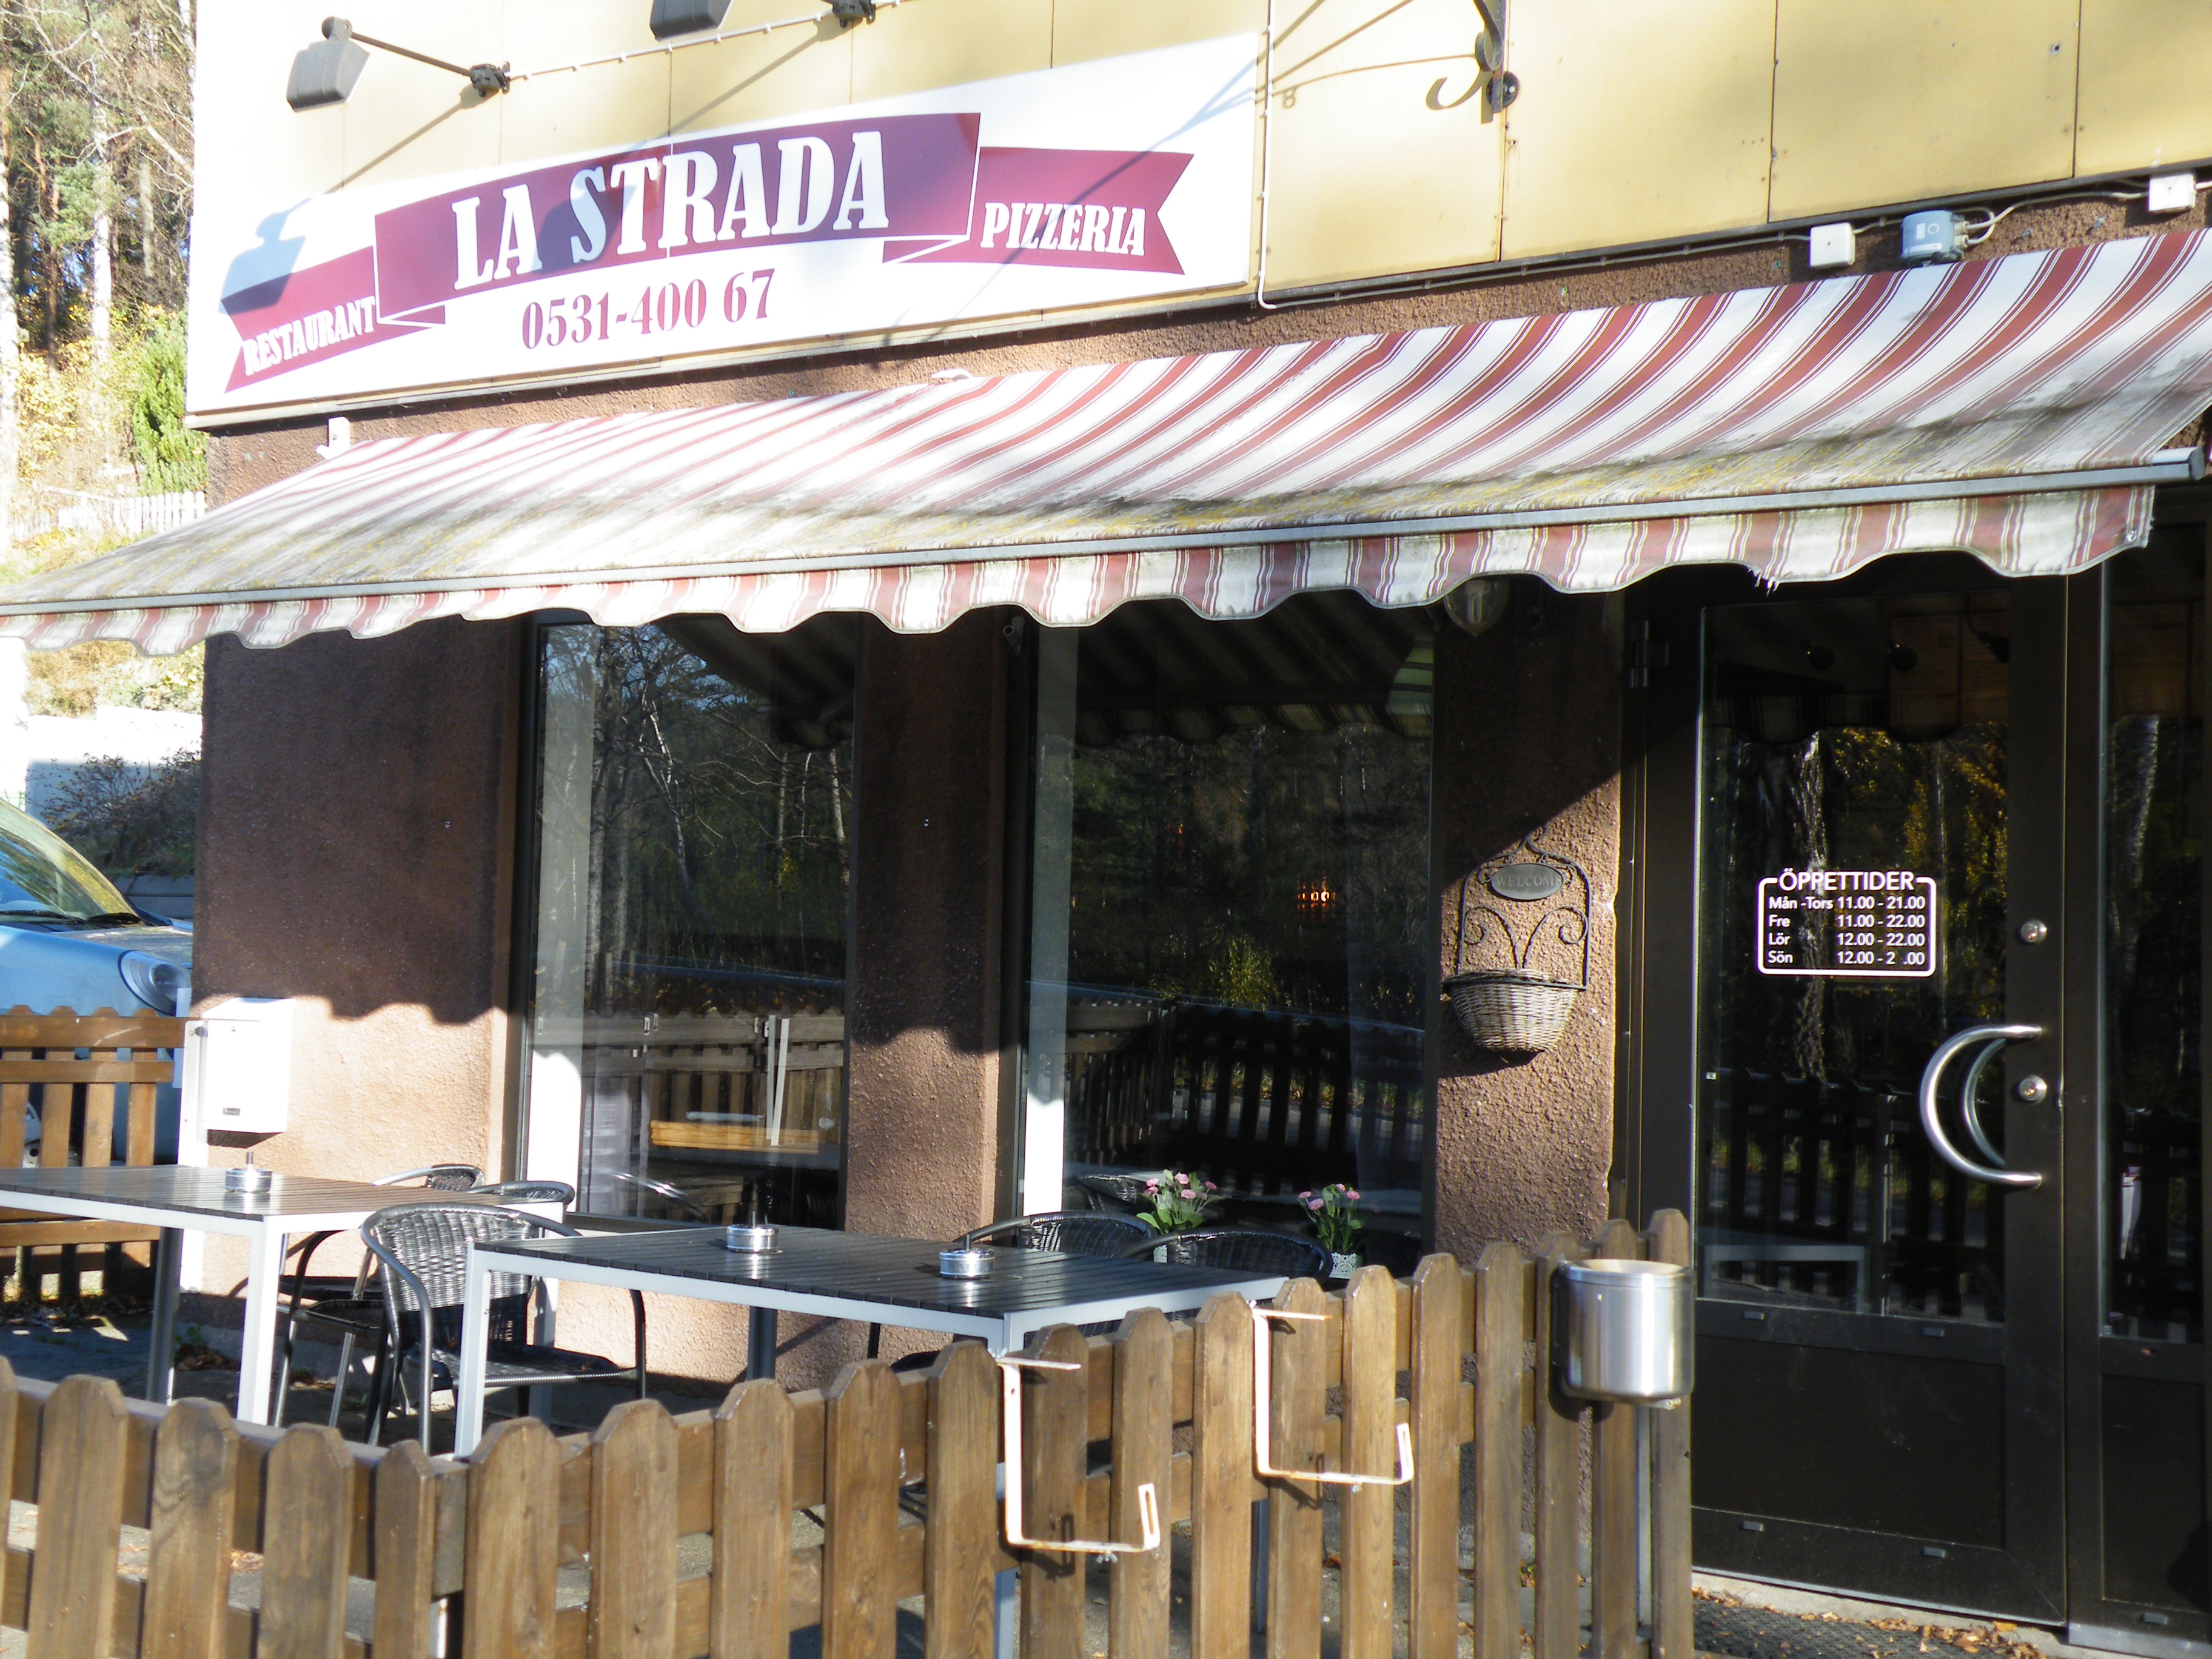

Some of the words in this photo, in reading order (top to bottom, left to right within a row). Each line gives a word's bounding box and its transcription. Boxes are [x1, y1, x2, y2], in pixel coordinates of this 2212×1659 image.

[452, 183, 543, 290] LA
[569, 130, 890, 264] STRADA
[980, 202, 1147, 256] PIZZERIA
[522, 278, 707, 349] 0531-400
[724, 268, 776, 323] 67
[243, 295, 376, 376] RESTAURANT
[1778, 867, 1915, 891] ÖPPETTIDER
[1768, 896, 1798, 910] Mån
[1837, 896, 1875, 910] 11.00
[1886, 896, 1926, 910] 21.00
[1768, 914, 1791, 927] Fre
[1837, 914, 1875, 928] 11.00
[1886, 914, 1926, 928] 22.00
[1768, 932, 1791, 946] Lör
[1837, 933, 1875, 947] 12.00
[1886, 933, 1926, 947] 22.00
[1768, 950, 1794, 964] Sön
[1837, 951, 1875, 965] 12.00
